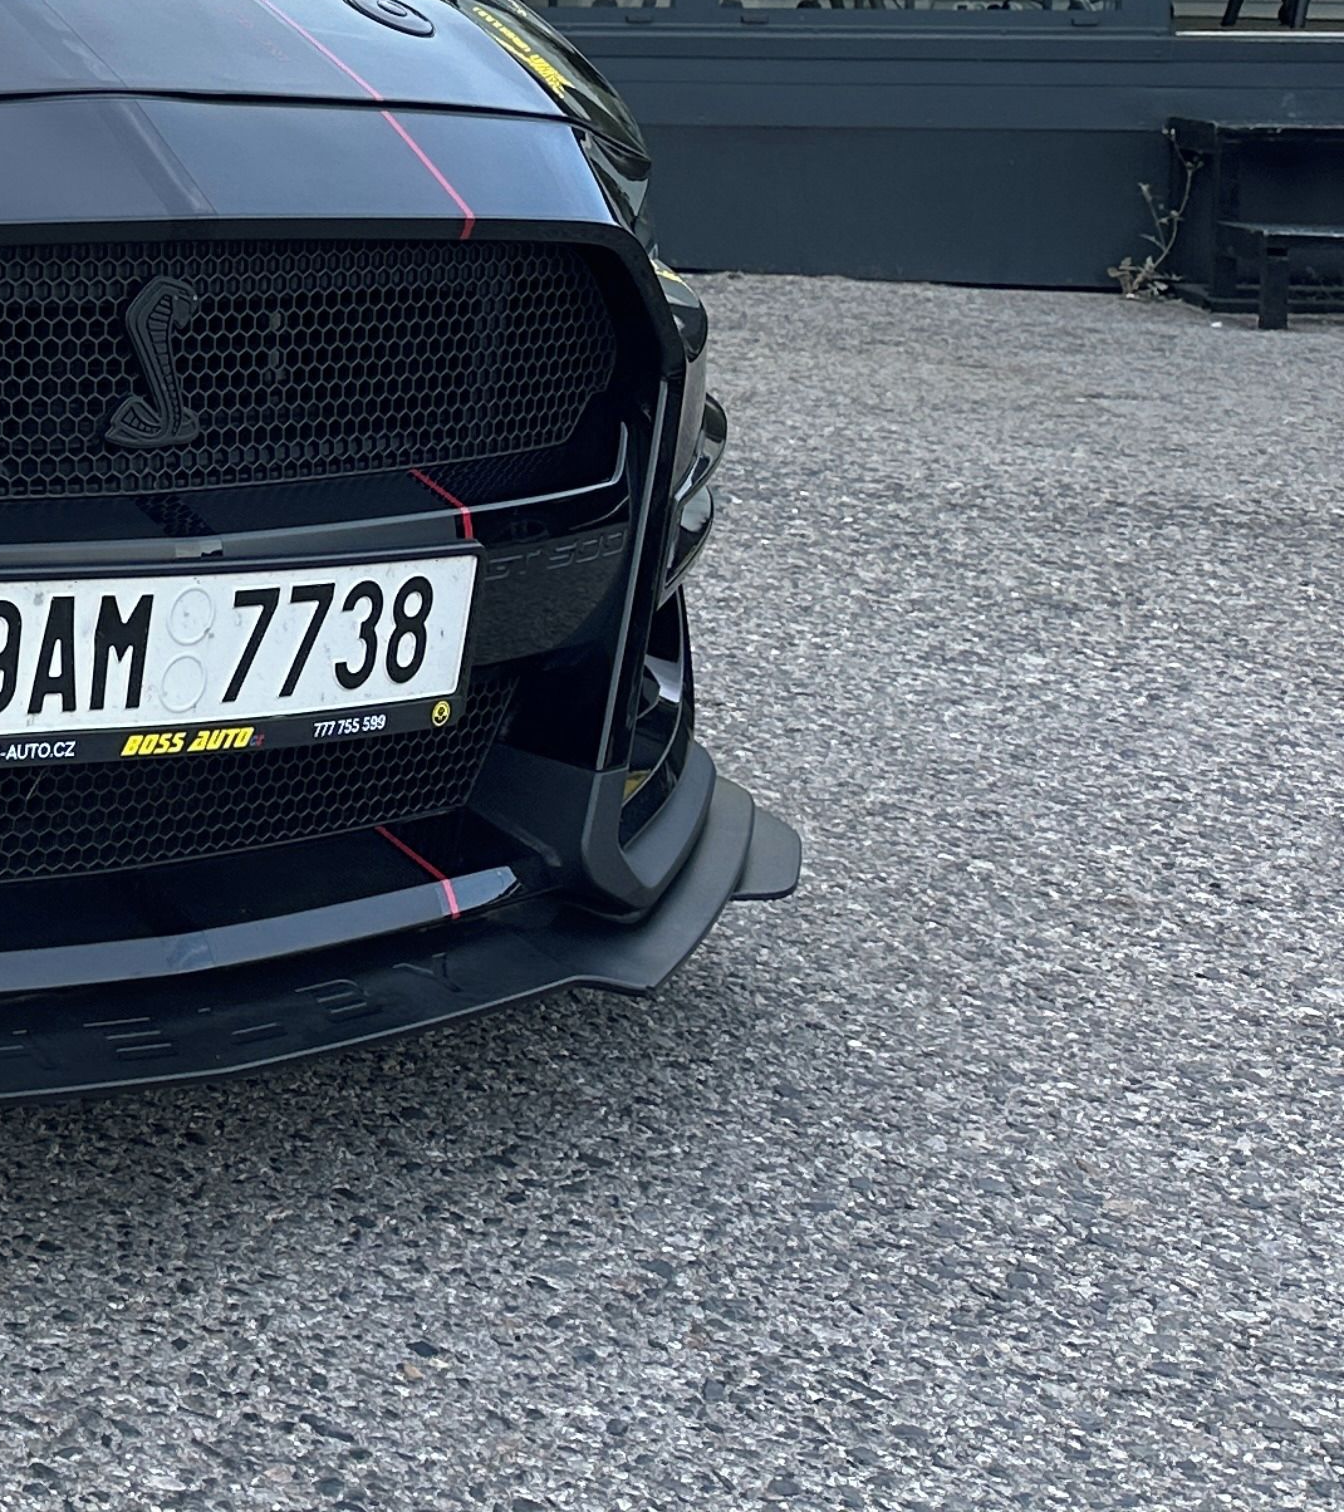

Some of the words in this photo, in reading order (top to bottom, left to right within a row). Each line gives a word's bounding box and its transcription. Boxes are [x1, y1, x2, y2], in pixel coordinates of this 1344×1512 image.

[220, 575, 434, 703] 7738
[120, 731, 187, 756] BOSS
[187, 726, 255, 752] AUTO
[313, 720, 336, 738] 777
[338, 717, 360, 735] 755
[362, 714, 386, 732] 599
